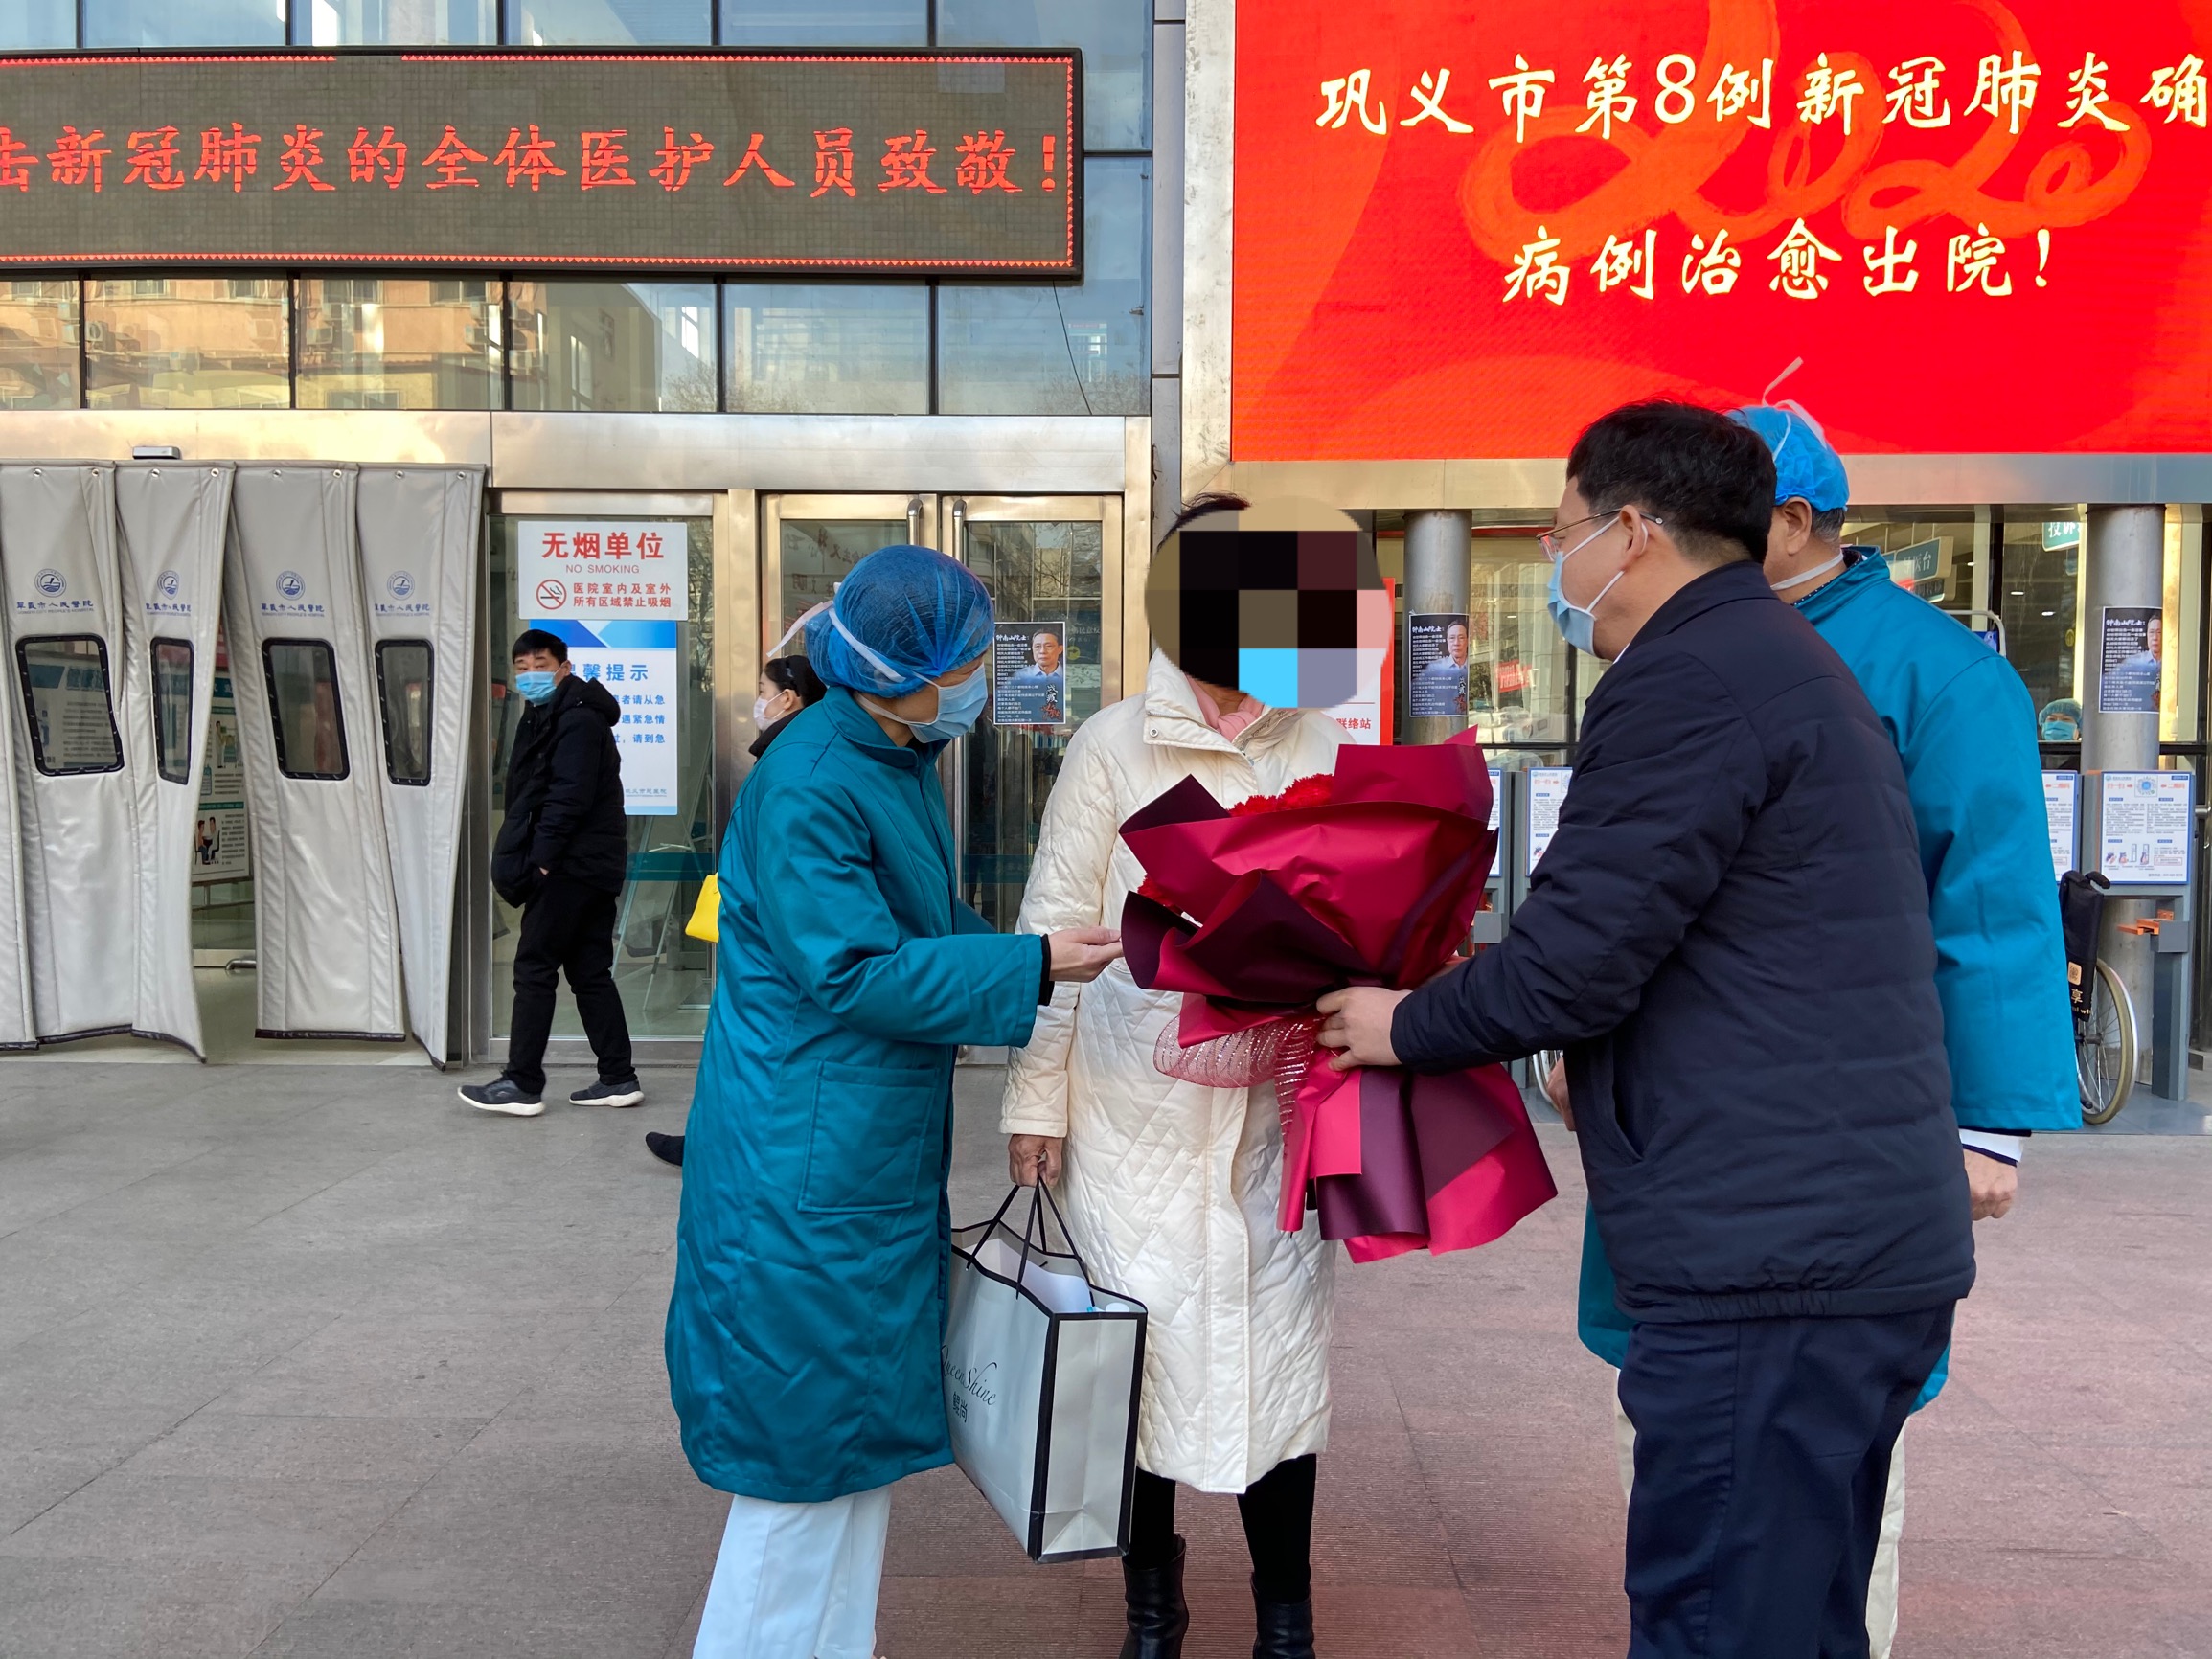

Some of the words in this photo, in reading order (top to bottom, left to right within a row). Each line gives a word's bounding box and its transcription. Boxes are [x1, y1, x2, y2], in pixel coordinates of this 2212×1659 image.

[1315, 50, 2208, 144] 巩义市第8例新冠肺炎确
[1503, 218, 2052, 307] 病例治愈出院!
[541, 531, 664, 560] 无烟单位
[565, 564, 582, 574] NO
[587, 564, 640, 574] SMOKING
[573, 582, 672, 595] 医院室内及室外
[573, 596, 672, 608] 所有区域禁止吸烟
